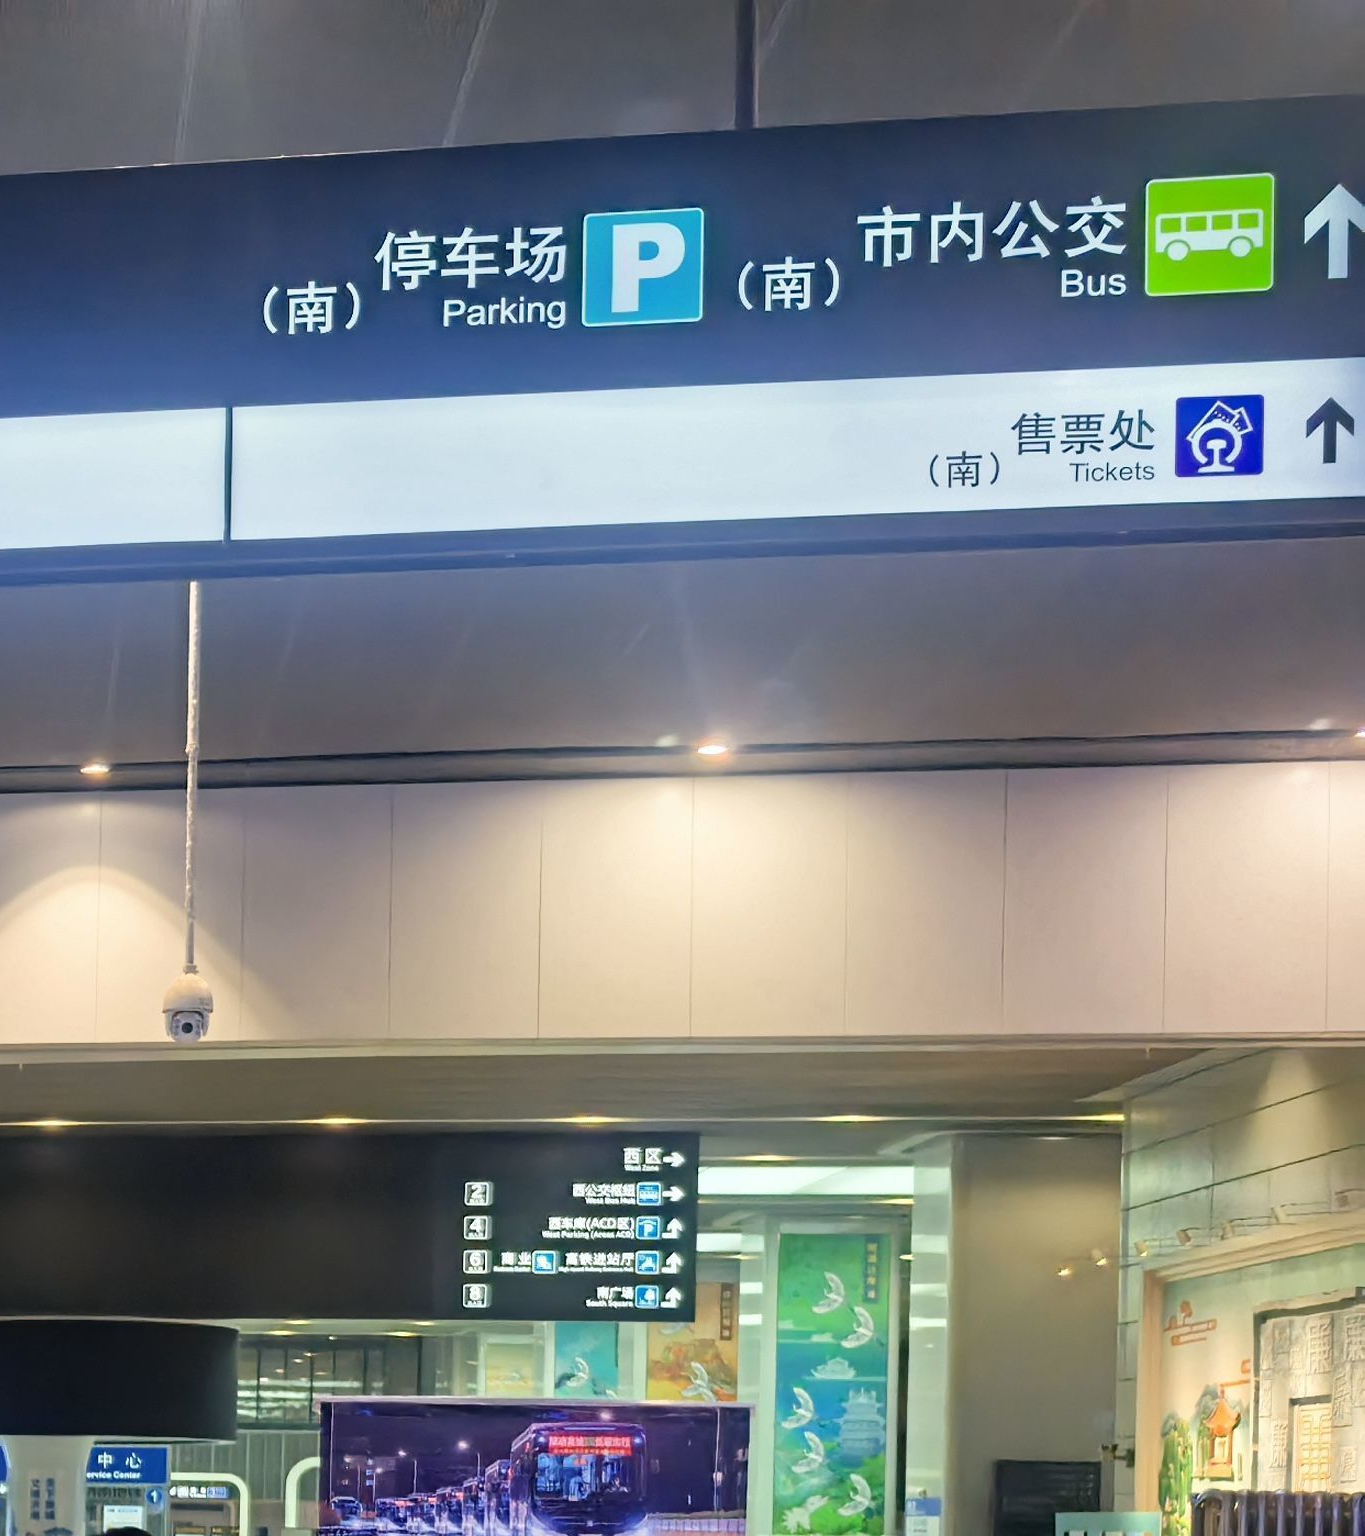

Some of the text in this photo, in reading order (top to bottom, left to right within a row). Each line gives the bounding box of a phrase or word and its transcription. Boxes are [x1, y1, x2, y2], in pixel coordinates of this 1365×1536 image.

[857, 195, 1127, 267] 市内公交
[375, 227, 566, 292] 停车场
[1060, 268, 1128, 298] Bus
[442, 296, 566, 330] Parking
[1010, 409, 1156, 456] 售票处
[1069, 459, 1156, 485] Tickets
